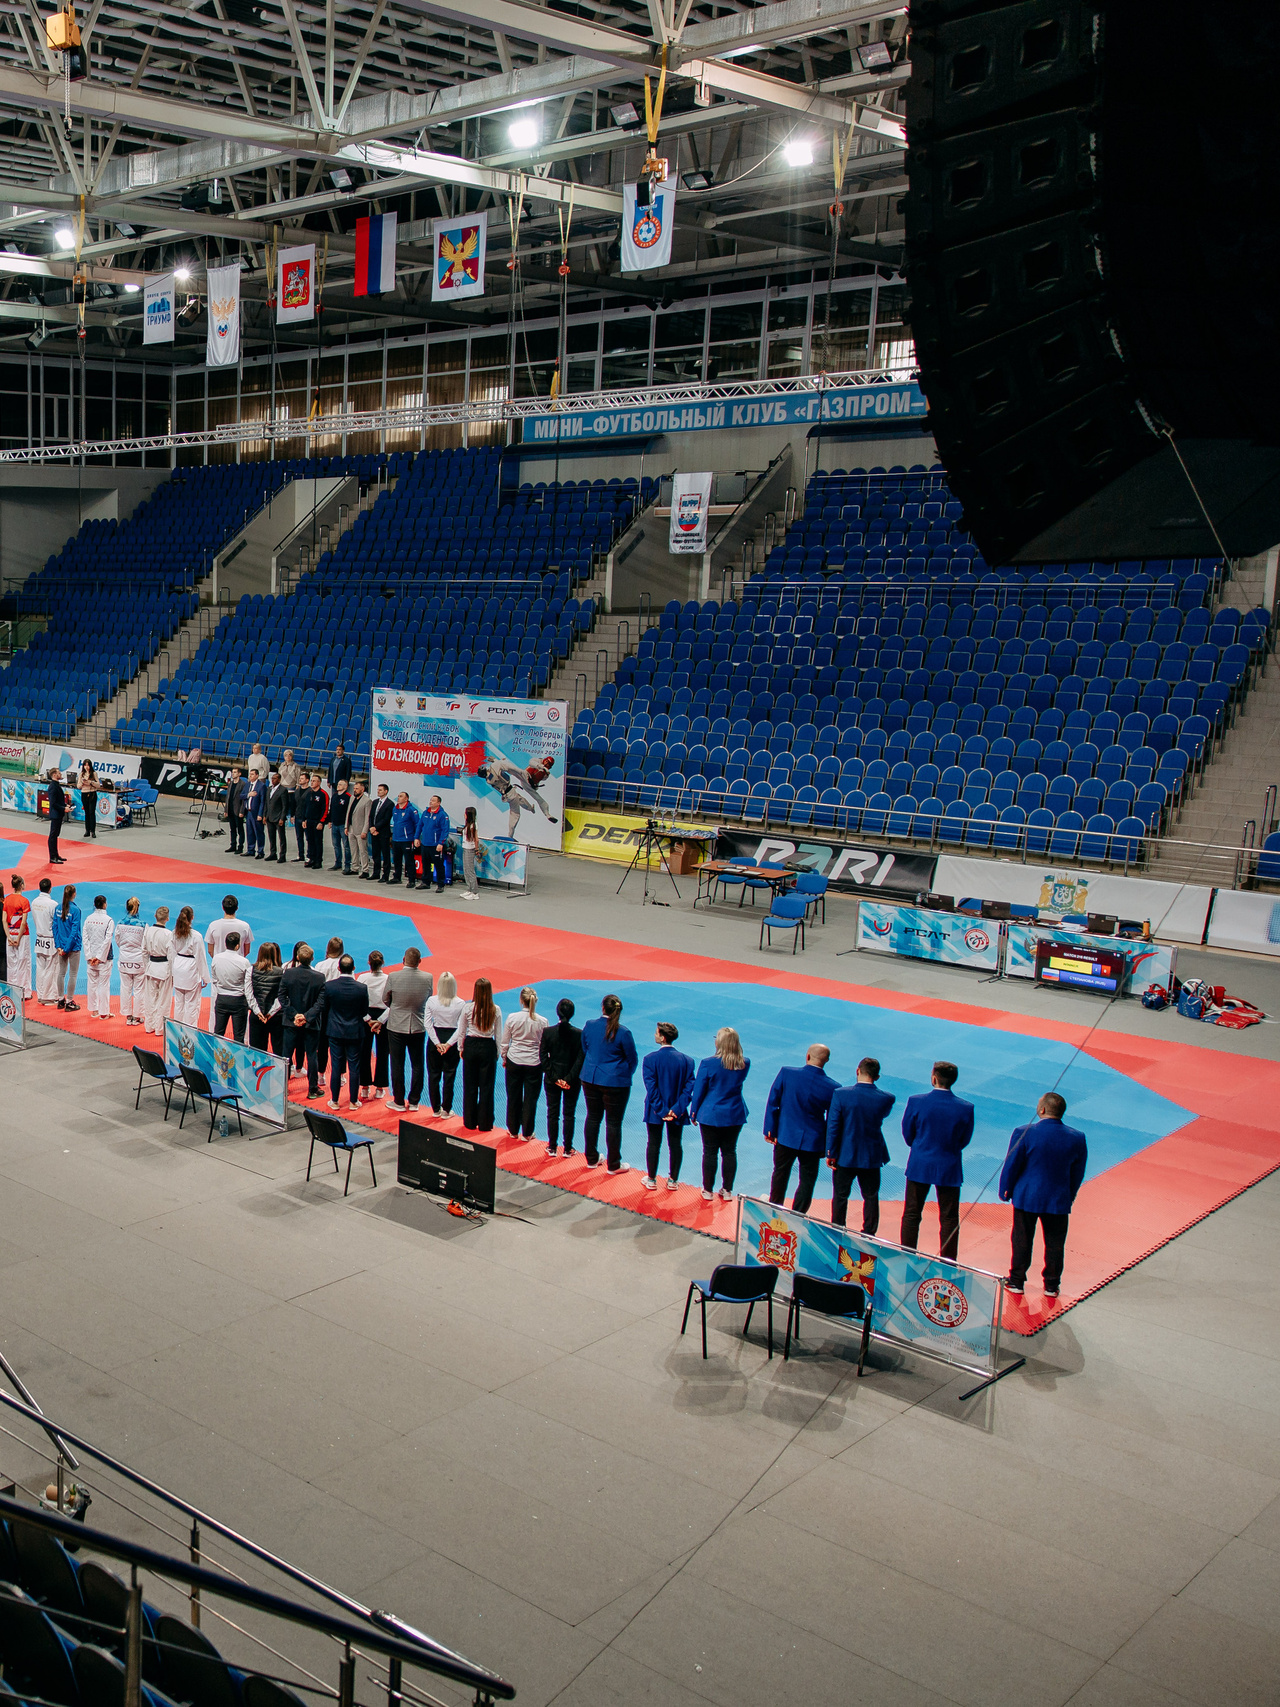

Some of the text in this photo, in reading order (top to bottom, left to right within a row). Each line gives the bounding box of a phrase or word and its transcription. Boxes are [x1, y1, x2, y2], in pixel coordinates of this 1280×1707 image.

[147, 312, 171, 326] ТРИУМФ
[534, 391, 926, 439] МИНИ-ФУТБОЛЬНЫЙ КЛУБ «ГАЗПРОМ-
[382, 718, 460, 733] ВСЕРОССИЙСКИЙ КУБОК
[381, 730, 460, 746] СРЕДИ СТУДЕНТОВ
[528, 728, 563, 740] Люберцы
[512, 737, 563, 749] ДС «Триумф»
[376, 747, 466, 770] по ТХЭКВОНДО (ВТФ)
[78, 759, 125, 775] НВАТЭК
[35, 938, 51, 950] RUS
